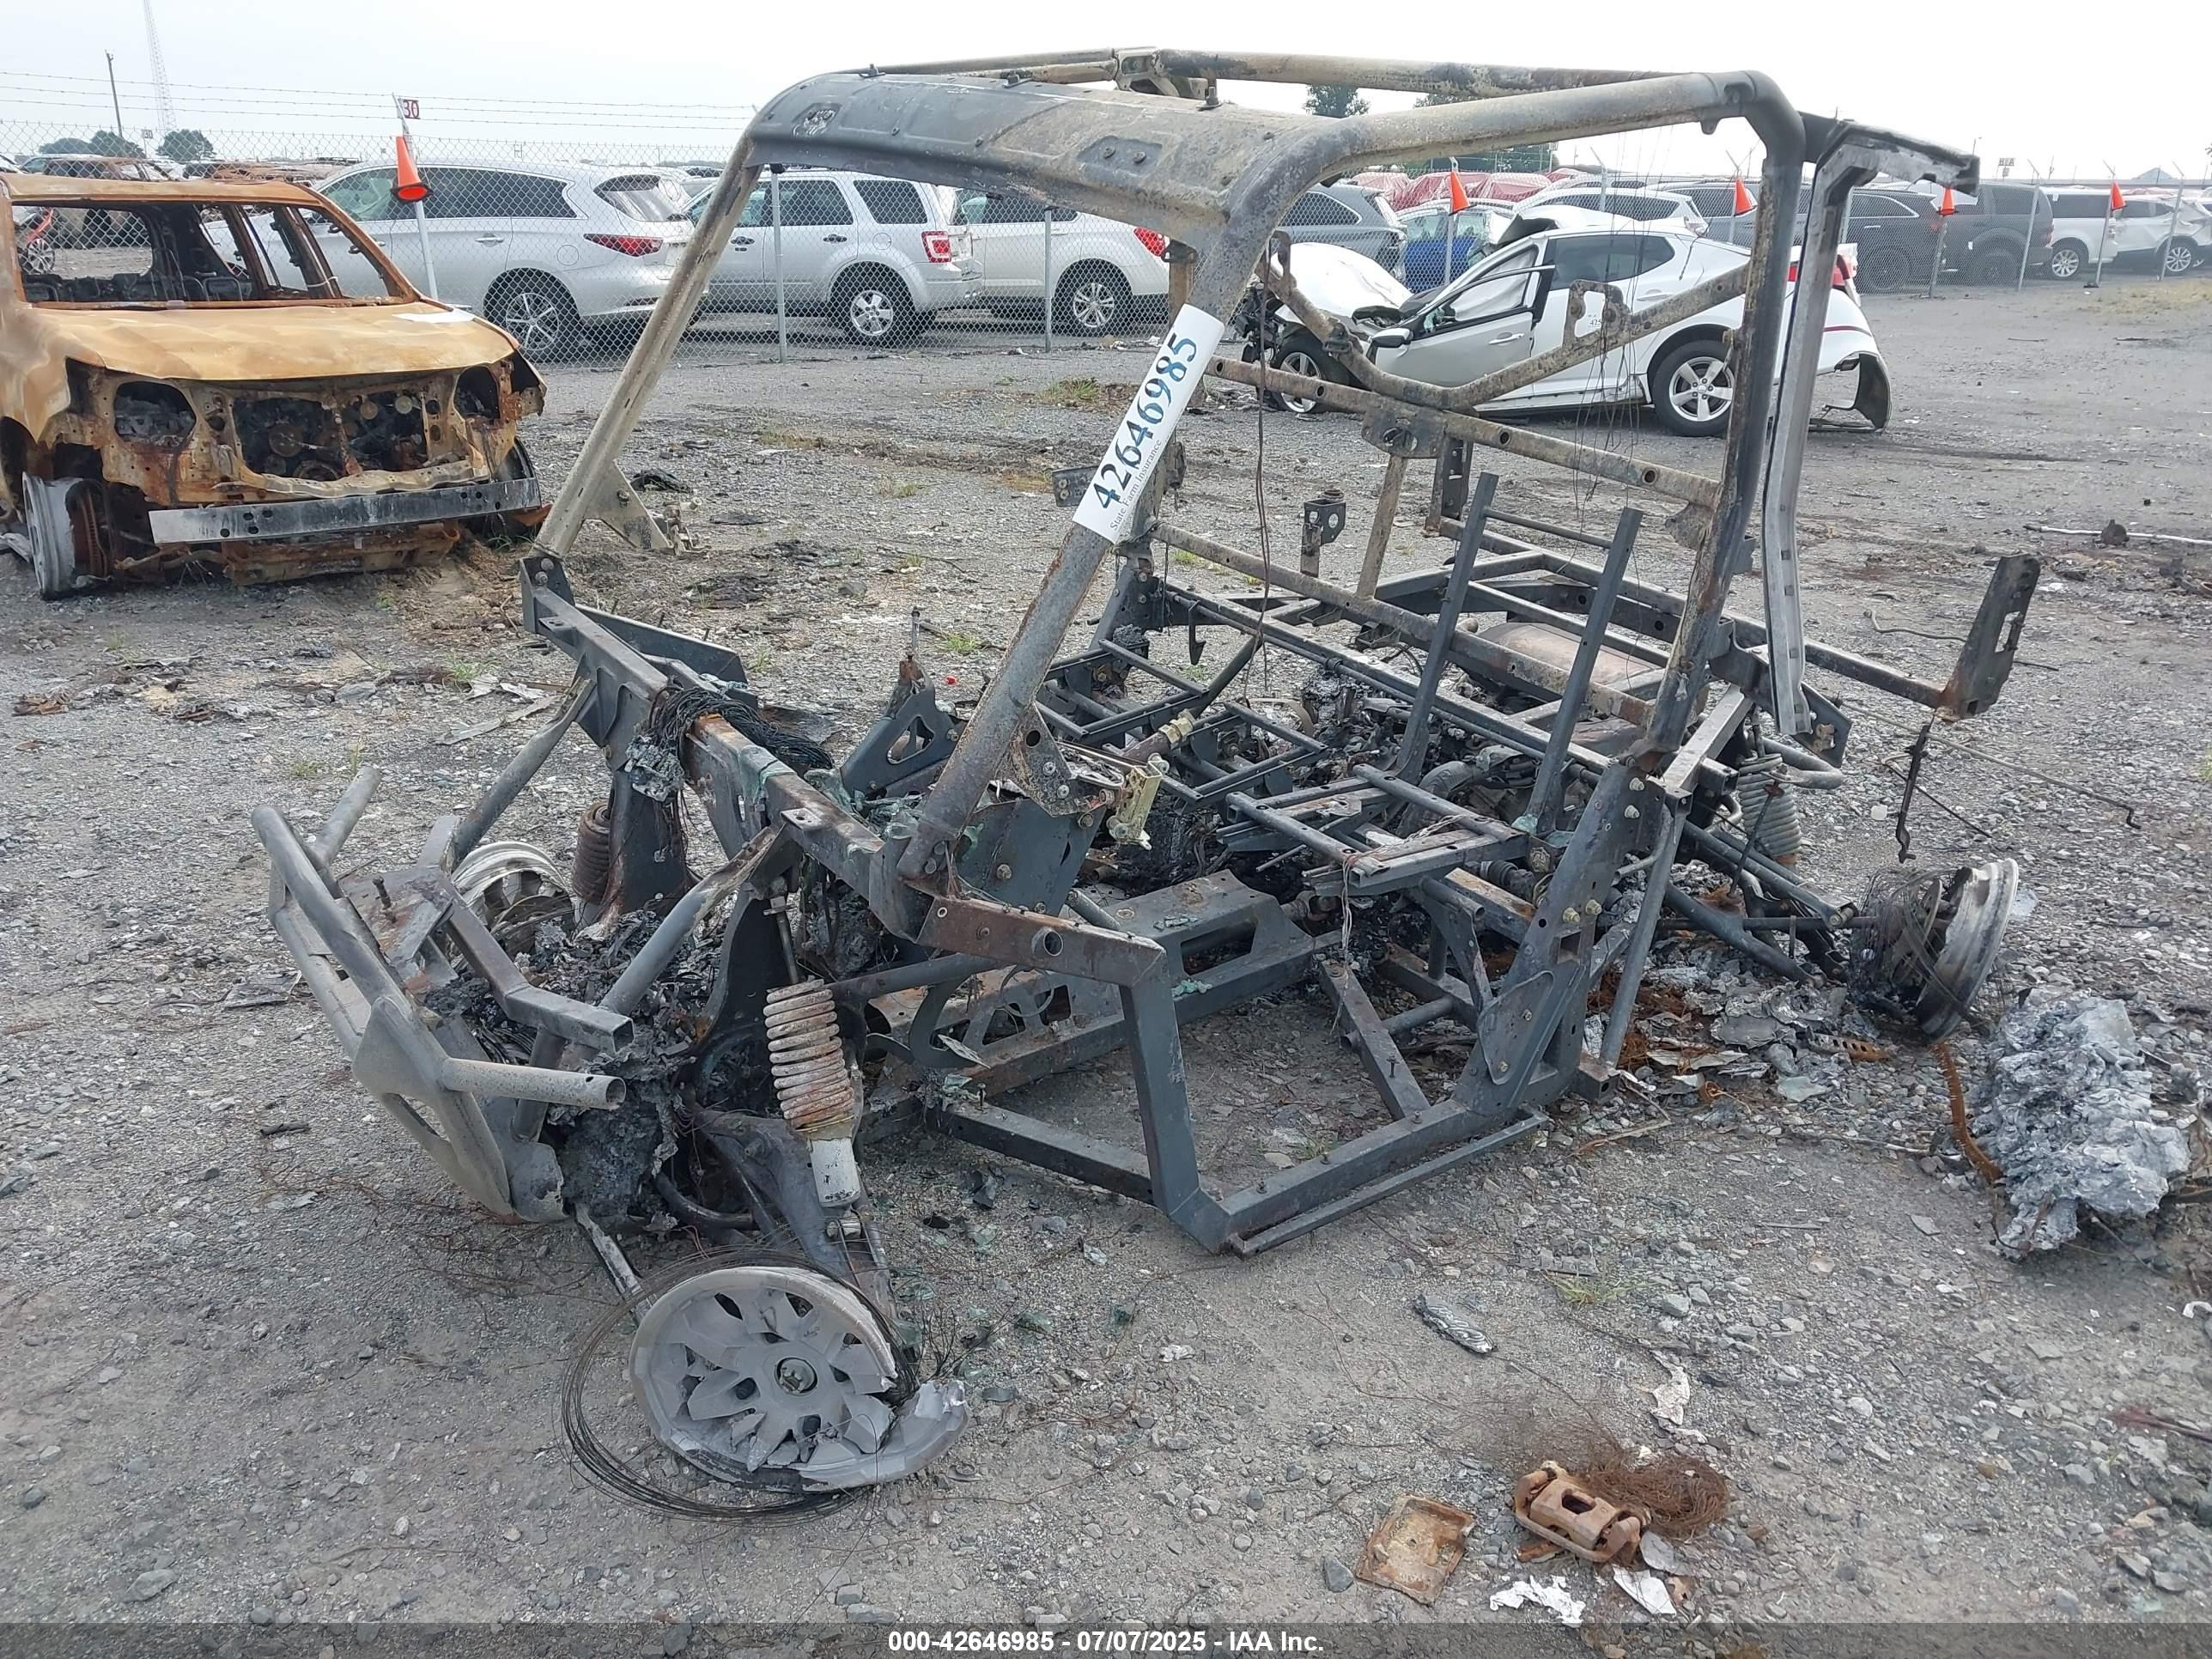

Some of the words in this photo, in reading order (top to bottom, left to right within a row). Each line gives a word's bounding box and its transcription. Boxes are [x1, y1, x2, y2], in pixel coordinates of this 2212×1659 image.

[403, 100, 420, 119] 30
[1093, 333, 1197, 508] 42646985
[1110, 508, 1127, 530] State
[1121, 484, 1139, 506] Farm
[1134, 439, 1162, 483] Insurance
